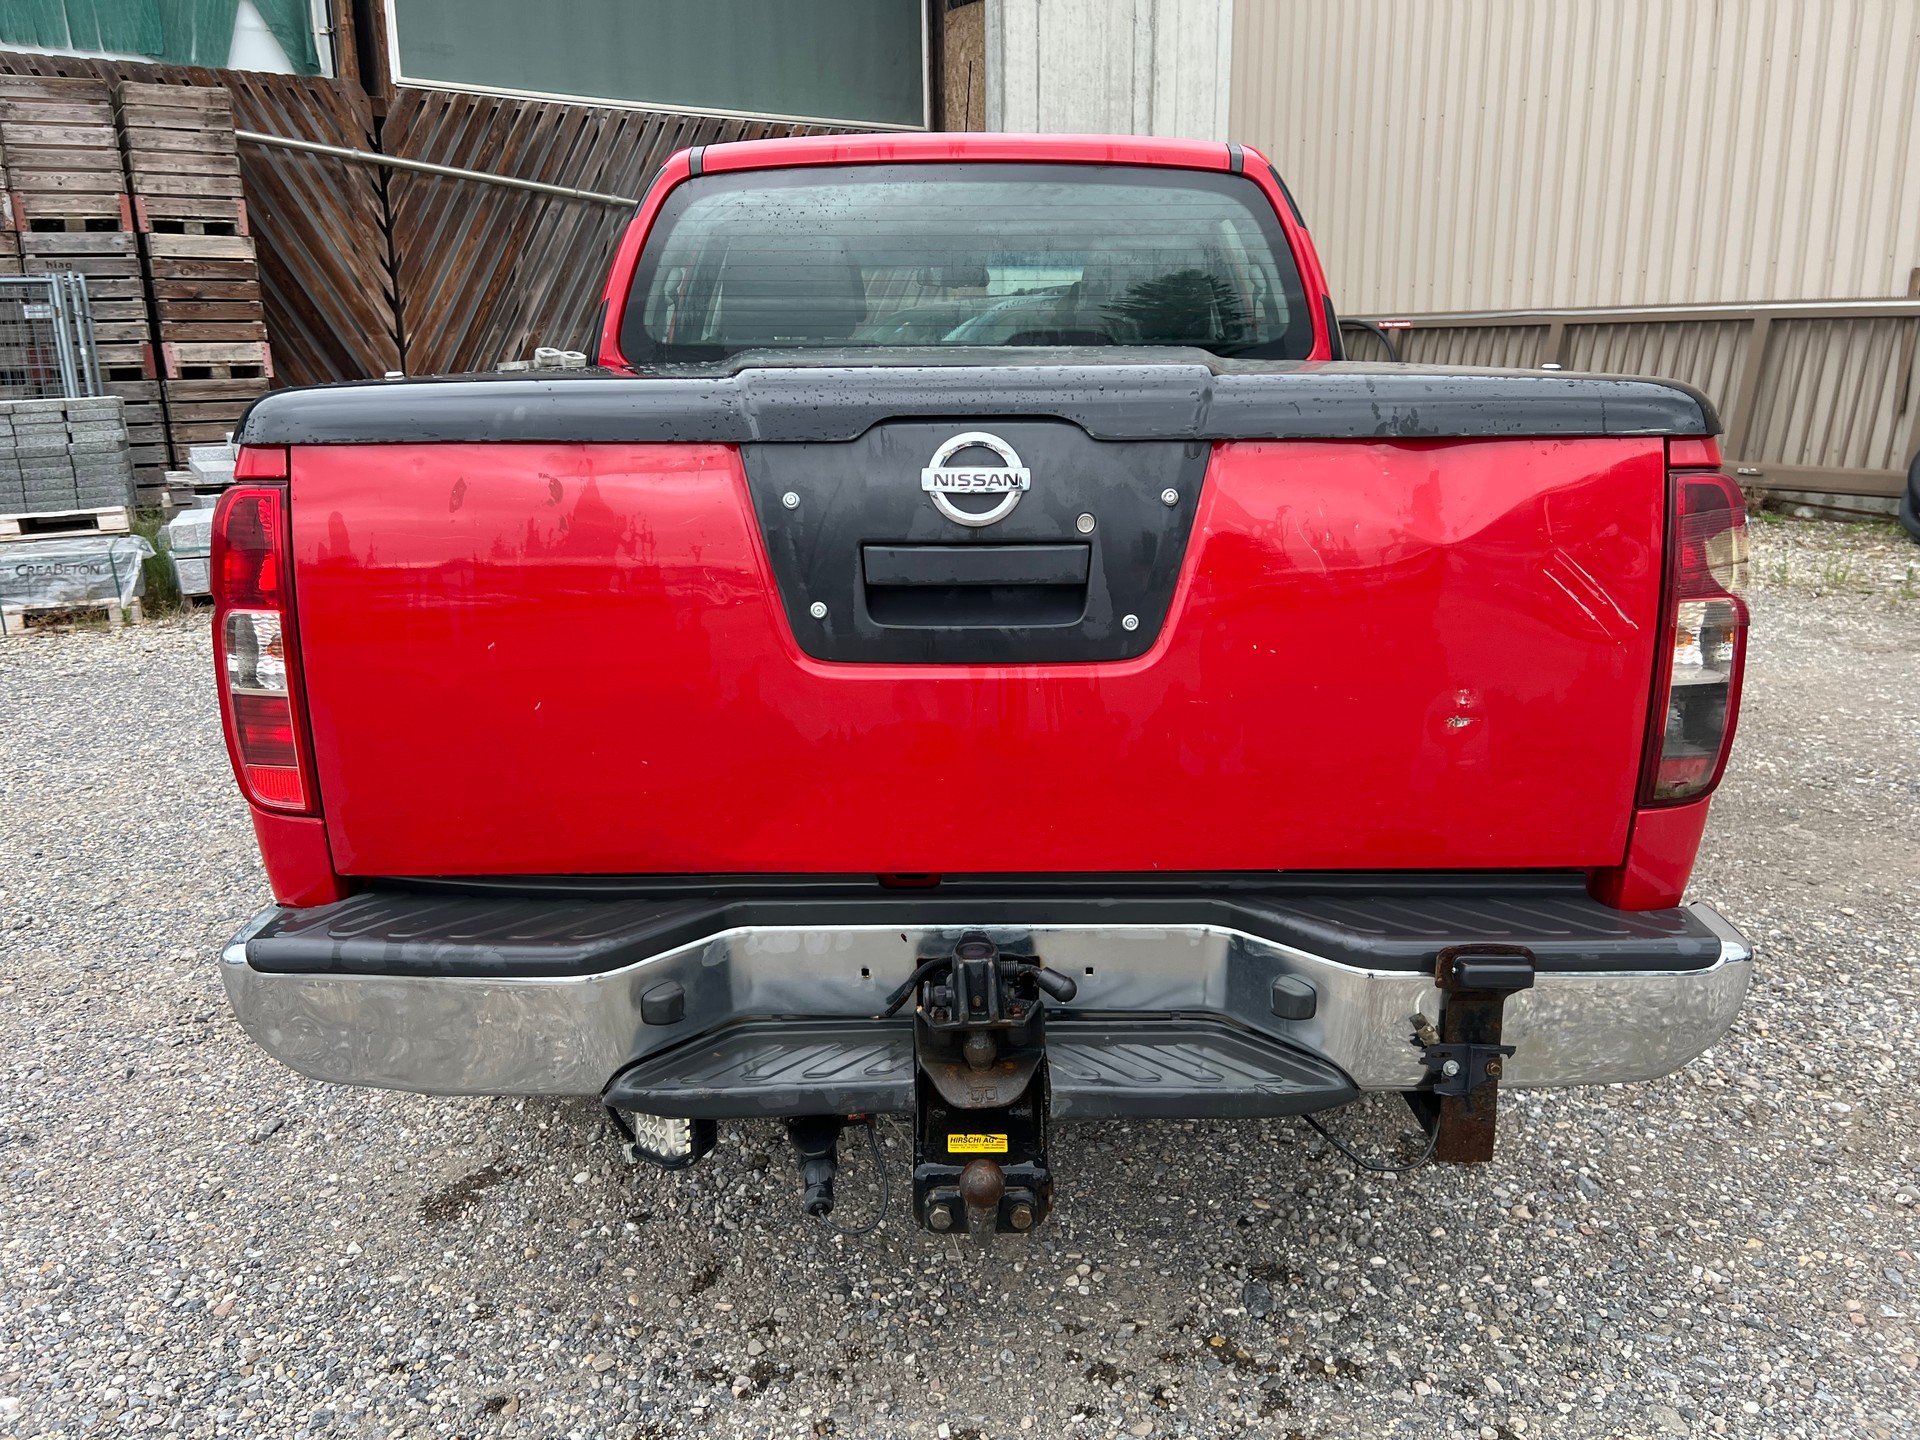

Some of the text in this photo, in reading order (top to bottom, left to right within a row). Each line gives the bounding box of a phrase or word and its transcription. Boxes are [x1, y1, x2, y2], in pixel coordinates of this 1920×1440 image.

[45, 261, 73, 272] hiag
[933, 473, 1019, 487] NISSAN
[950, 1136, 982, 1144] HIRSCHI
